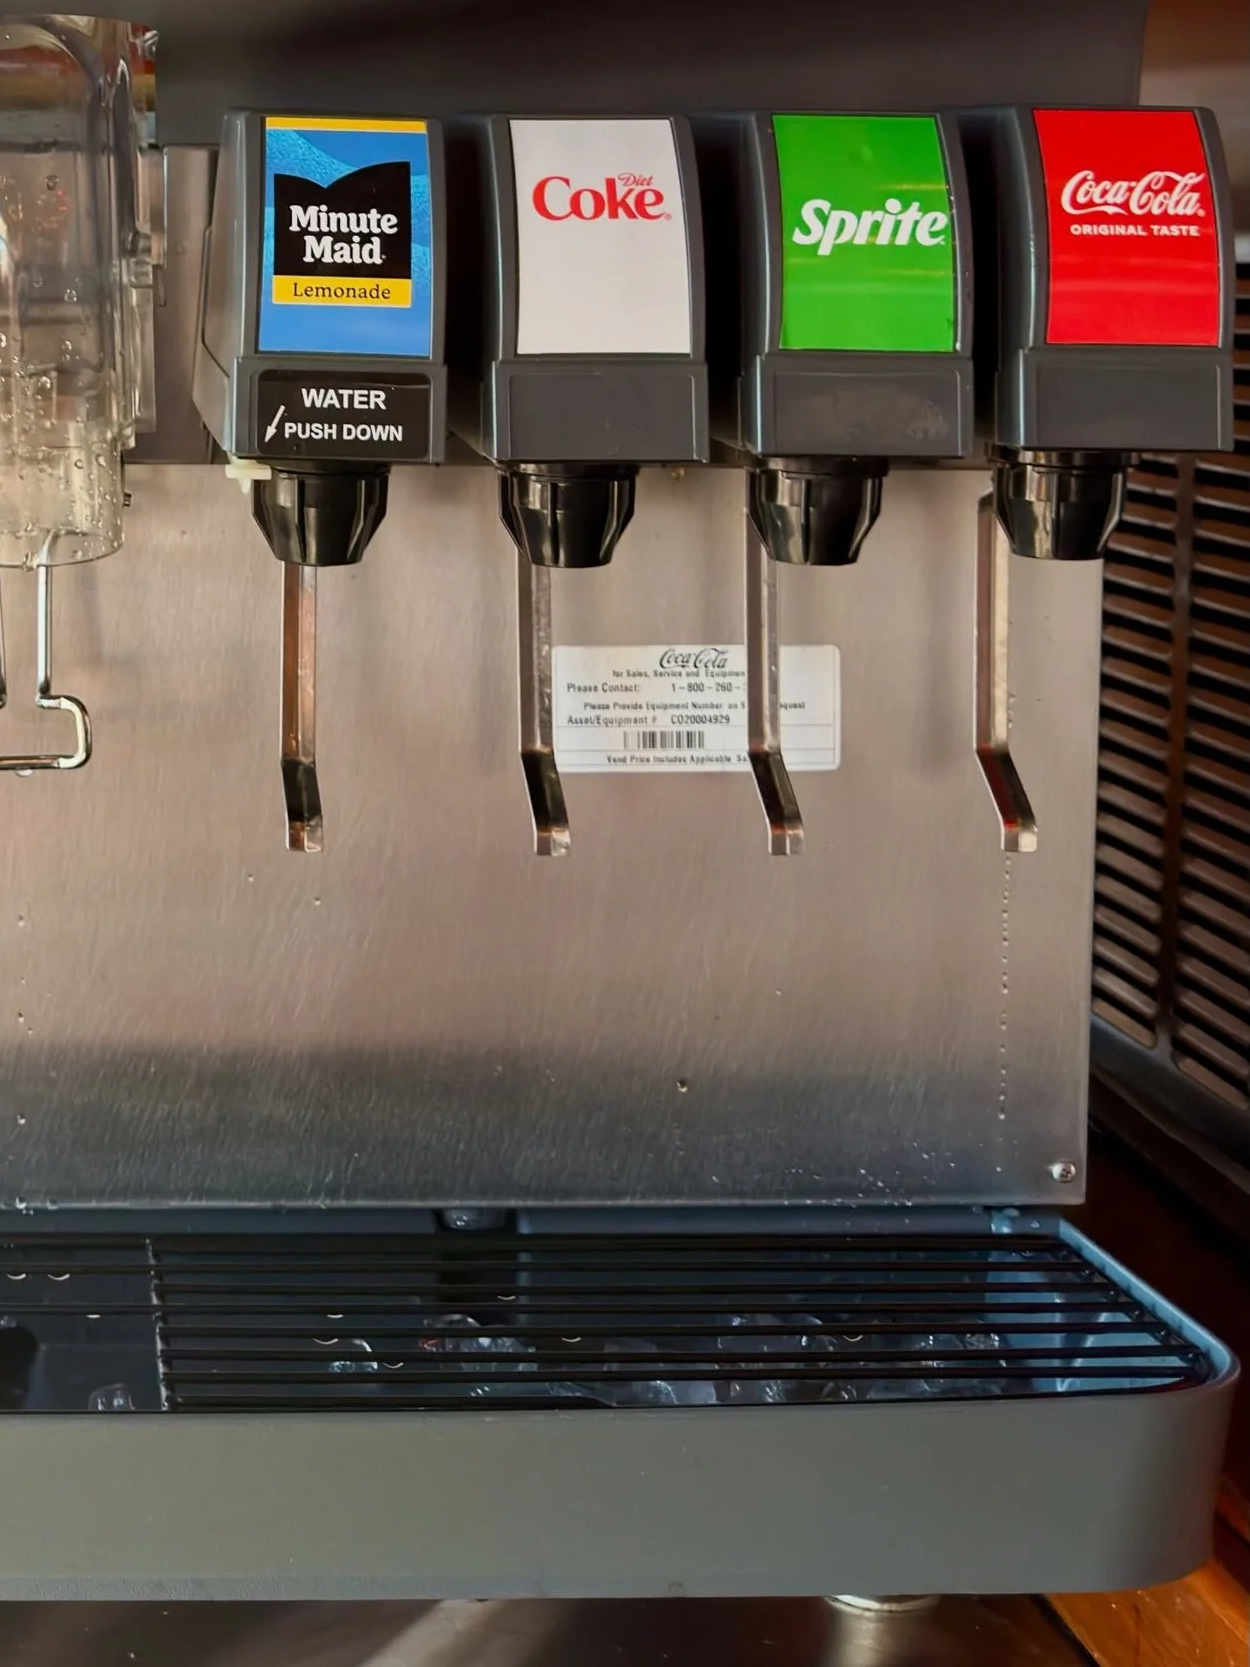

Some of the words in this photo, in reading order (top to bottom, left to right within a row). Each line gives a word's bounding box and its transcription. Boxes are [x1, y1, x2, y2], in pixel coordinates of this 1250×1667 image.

[617, 172, 654, 188] Diet
[532, 175, 665, 221] Coke
[1061, 170, 1206, 217] Coca-Cola
[288, 204, 399, 234] Minute
[792, 198, 949, 256] Sprite
[1070, 224, 1148, 237] ORIGINAL
[1150, 224, 1201, 237] TASTE
[301, 235, 383, 265] Maid
[292, 281, 391, 301] Lemonade
[301, 387, 387, 410] WATER
[284, 421, 338, 441] PUSH
[342, 423, 403, 442] DOWN
[659, 647, 729, 669] Coca-Cola
[653, 669, 682, 678] Service
[705, 669, 746, 679] Equipmen
[567, 682, 599, 693] Please
[646, 701, 689, 711] Equipment
[691, 701, 722, 710] Number
[567, 715, 648, 728] Asset/Equipment
